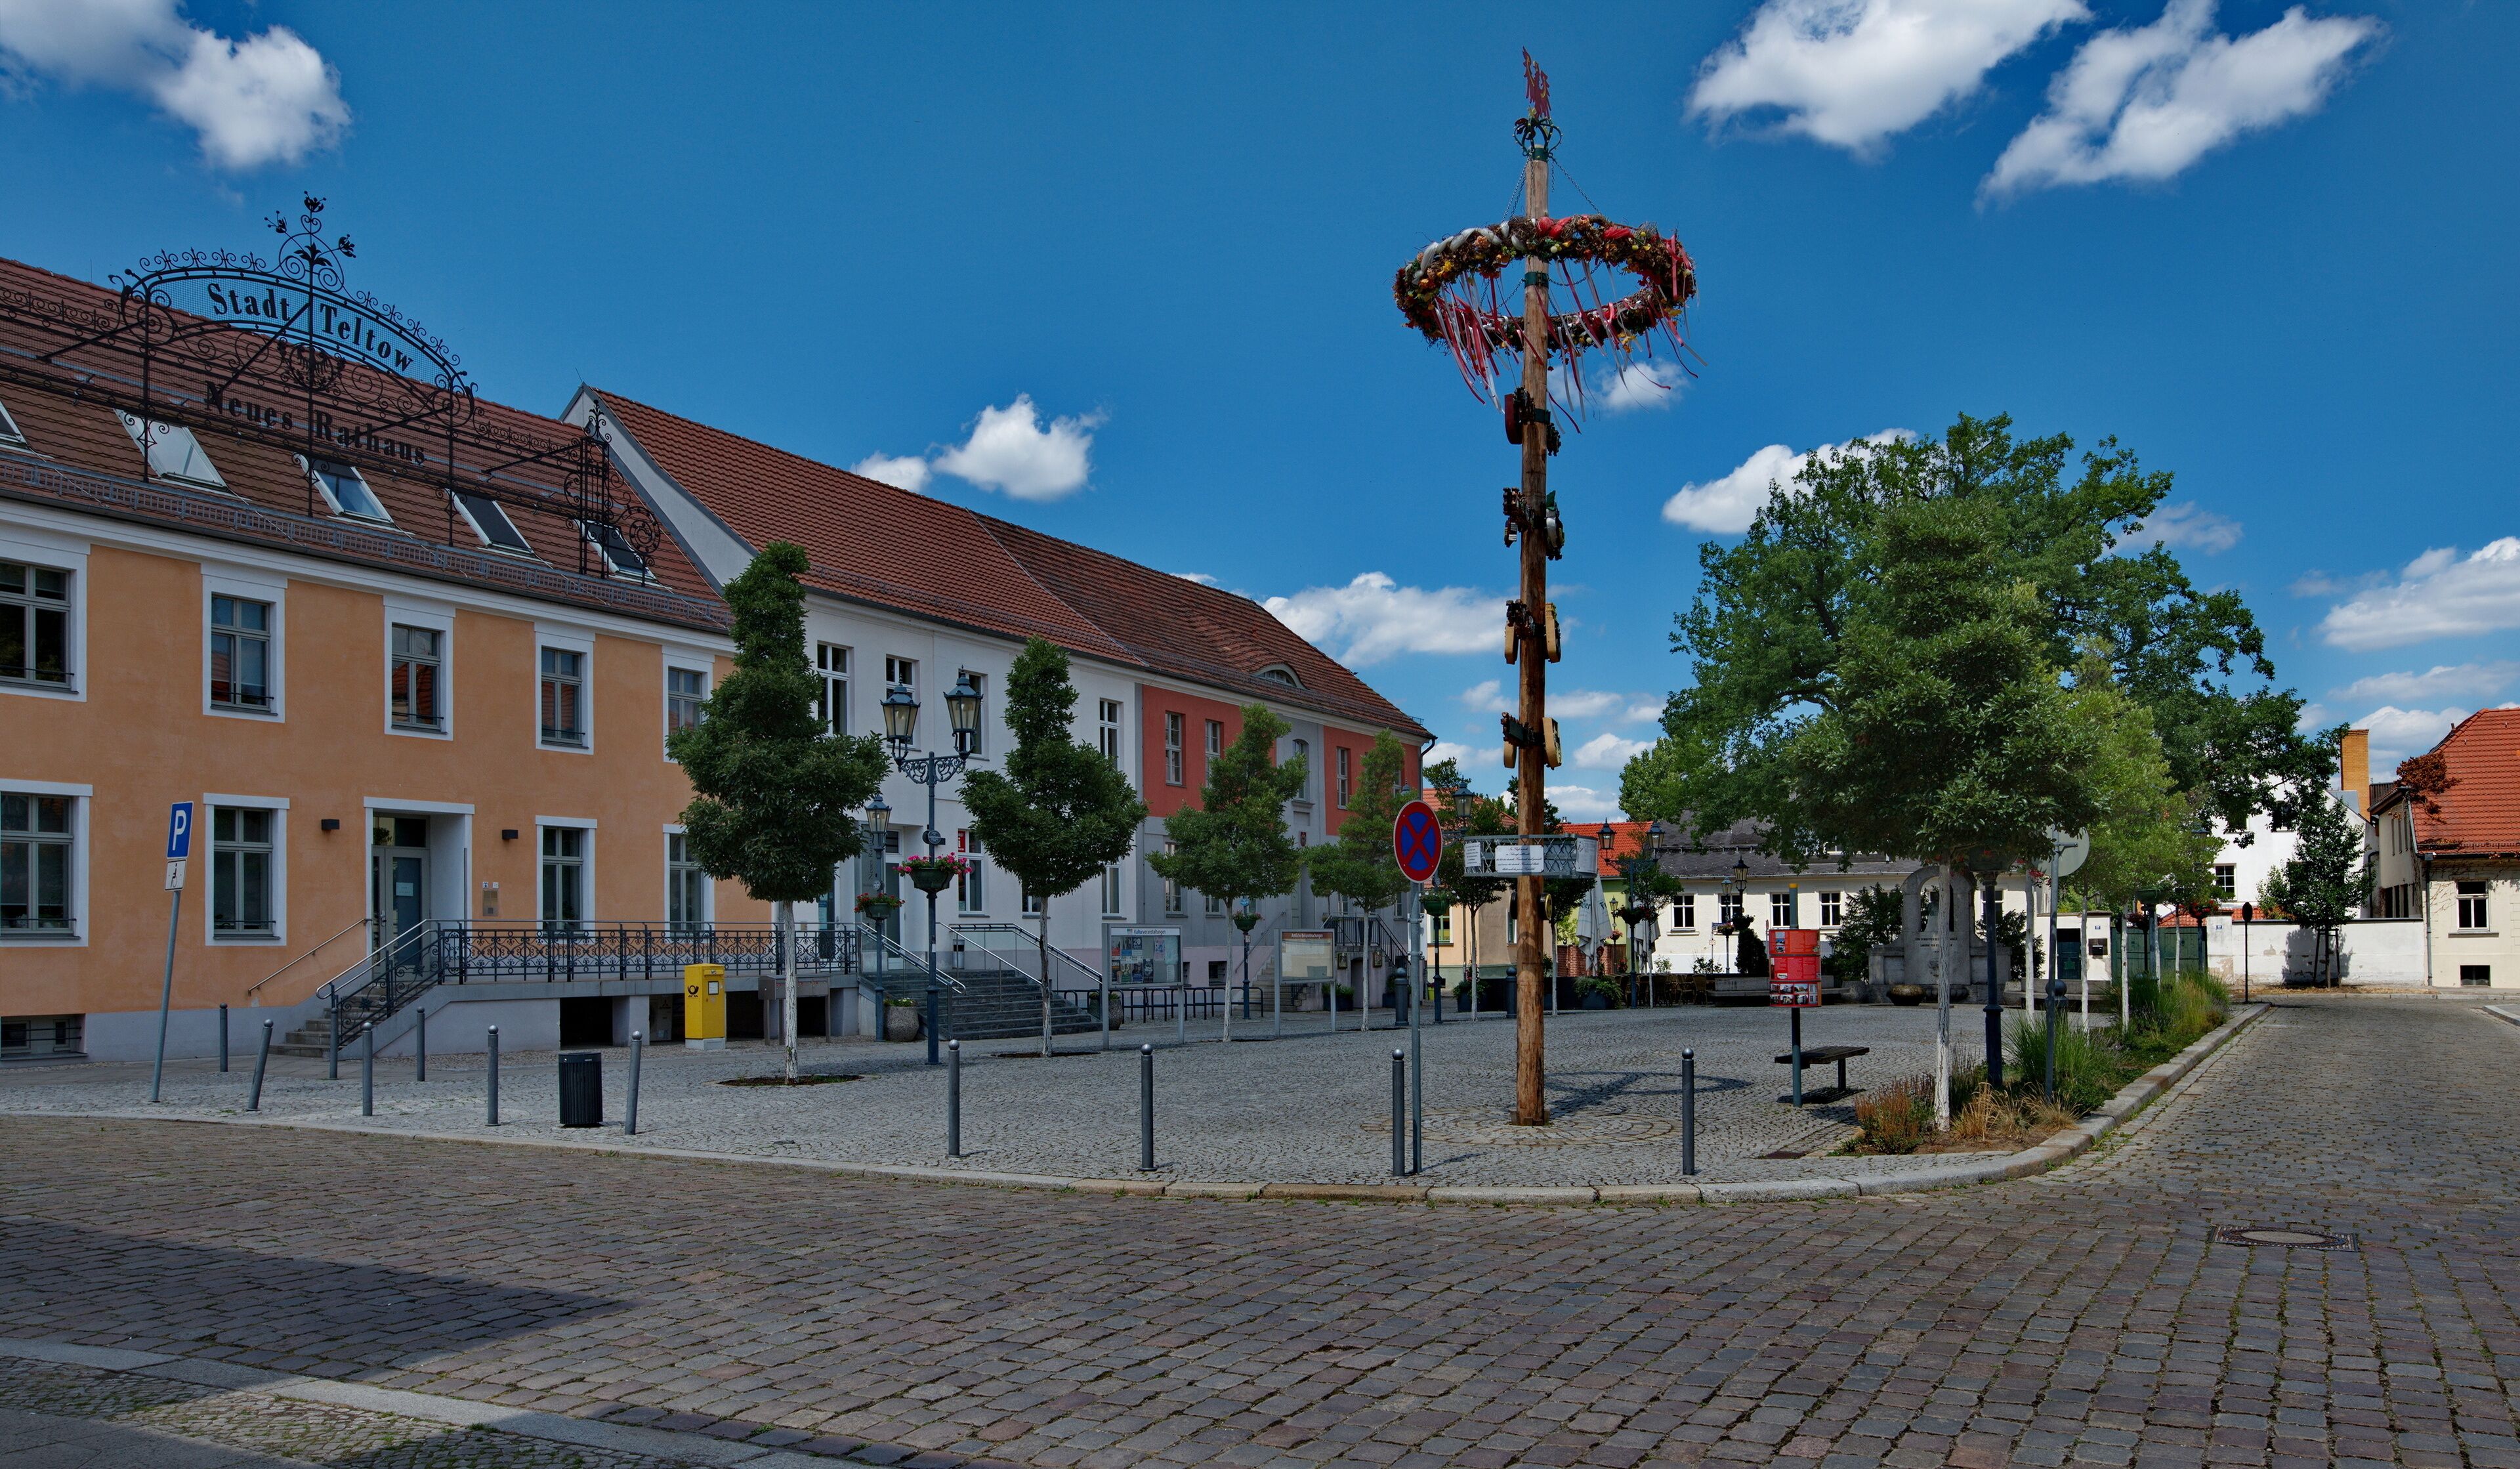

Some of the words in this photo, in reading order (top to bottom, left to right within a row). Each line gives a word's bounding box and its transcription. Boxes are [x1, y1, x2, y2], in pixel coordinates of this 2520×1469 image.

[207, 283, 291, 322] Stadt
[319, 303, 415, 372] Teltow
[205, 380, 293, 431] Neues
[314, 409, 425, 465] Rathaus
[172, 809, 187, 851] P
